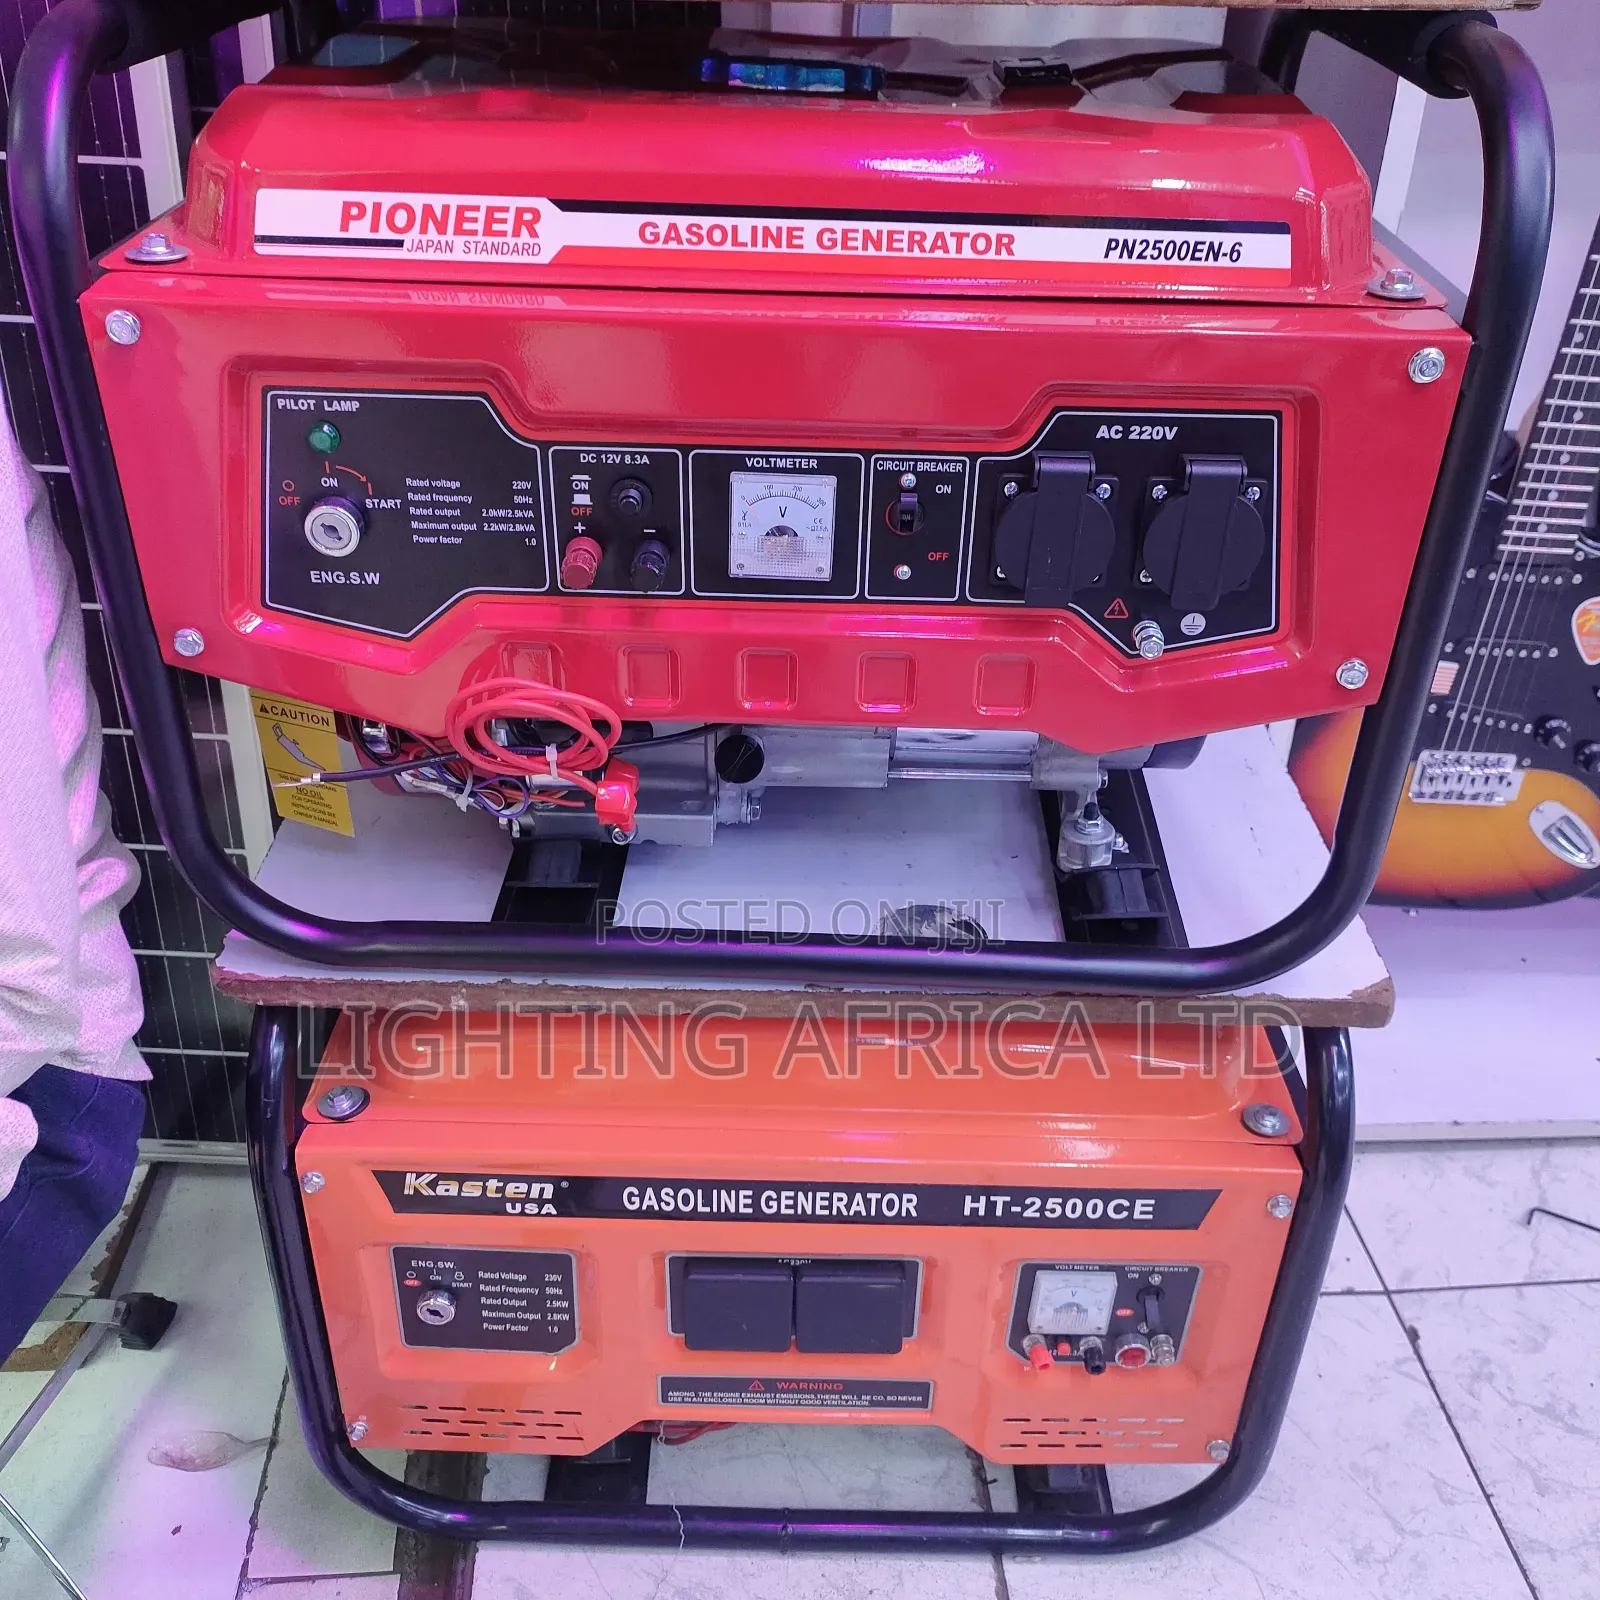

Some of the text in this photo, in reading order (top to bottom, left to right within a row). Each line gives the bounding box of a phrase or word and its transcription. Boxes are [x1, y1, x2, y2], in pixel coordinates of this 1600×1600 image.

[340, 200, 541, 239] PIONEER
[407, 239, 542, 256] JAPAN STANDARD
[638, 221, 1243, 263] GASOLINE GENERATOR PN2500EN-6
[277, 398, 360, 412] PILOT LAMP
[1096, 425, 1178, 440] AC 220V
[580, 453, 650, 464] DC 12V 8.3A
[745, 457, 818, 469] VOLTMETER
[876, 461, 963, 472] CIRCUIT BREAKER
[321, 477, 338, 488] ON
[405, 478, 532, 489] Rated voltage 220V
[572, 481, 589, 490] ON
[935, 485, 952, 494] ON
[278, 496, 300, 506] OFF
[407, 492, 533, 504] Rated frequency 50Hz
[365, 499, 402, 509] START
[409, 507, 535, 518] Rated output 2.0kW/2.5kVA
[571, 507, 592, 516] OFF
[779, 506, 788, 518] V
[411, 521, 449, 530] Maximum
[451, 522, 477, 532] output
[412, 535, 537, 546] Power factor 1.0
[928, 552, 949, 561] OFF
[310, 570, 380, 585] ENG.S.W
[270, 705, 330, 727] CAUTION
[296, 786, 309, 795] NO
[403, 1172, 555, 1199] Kasten
[505, 1202, 557, 1215] USA
[622, 1186, 1156, 1220] GASOLINE GENERATOR HT-2500CE
[478, 1271, 563, 1282] Rated Voltage 230V
[451, 1281, 473, 1289] START
[479, 1284, 563, 1295] Rated Frequency 50Hz
[480, 1297, 569, 1308] Rated Output 2.5KW
[482, 1310, 570, 1321] Maximum Output 2.8KW
[483, 1323, 505, 1331] Power
[506, 1324, 529, 1332] Factor
[776, 1381, 844, 1390] WARNING
